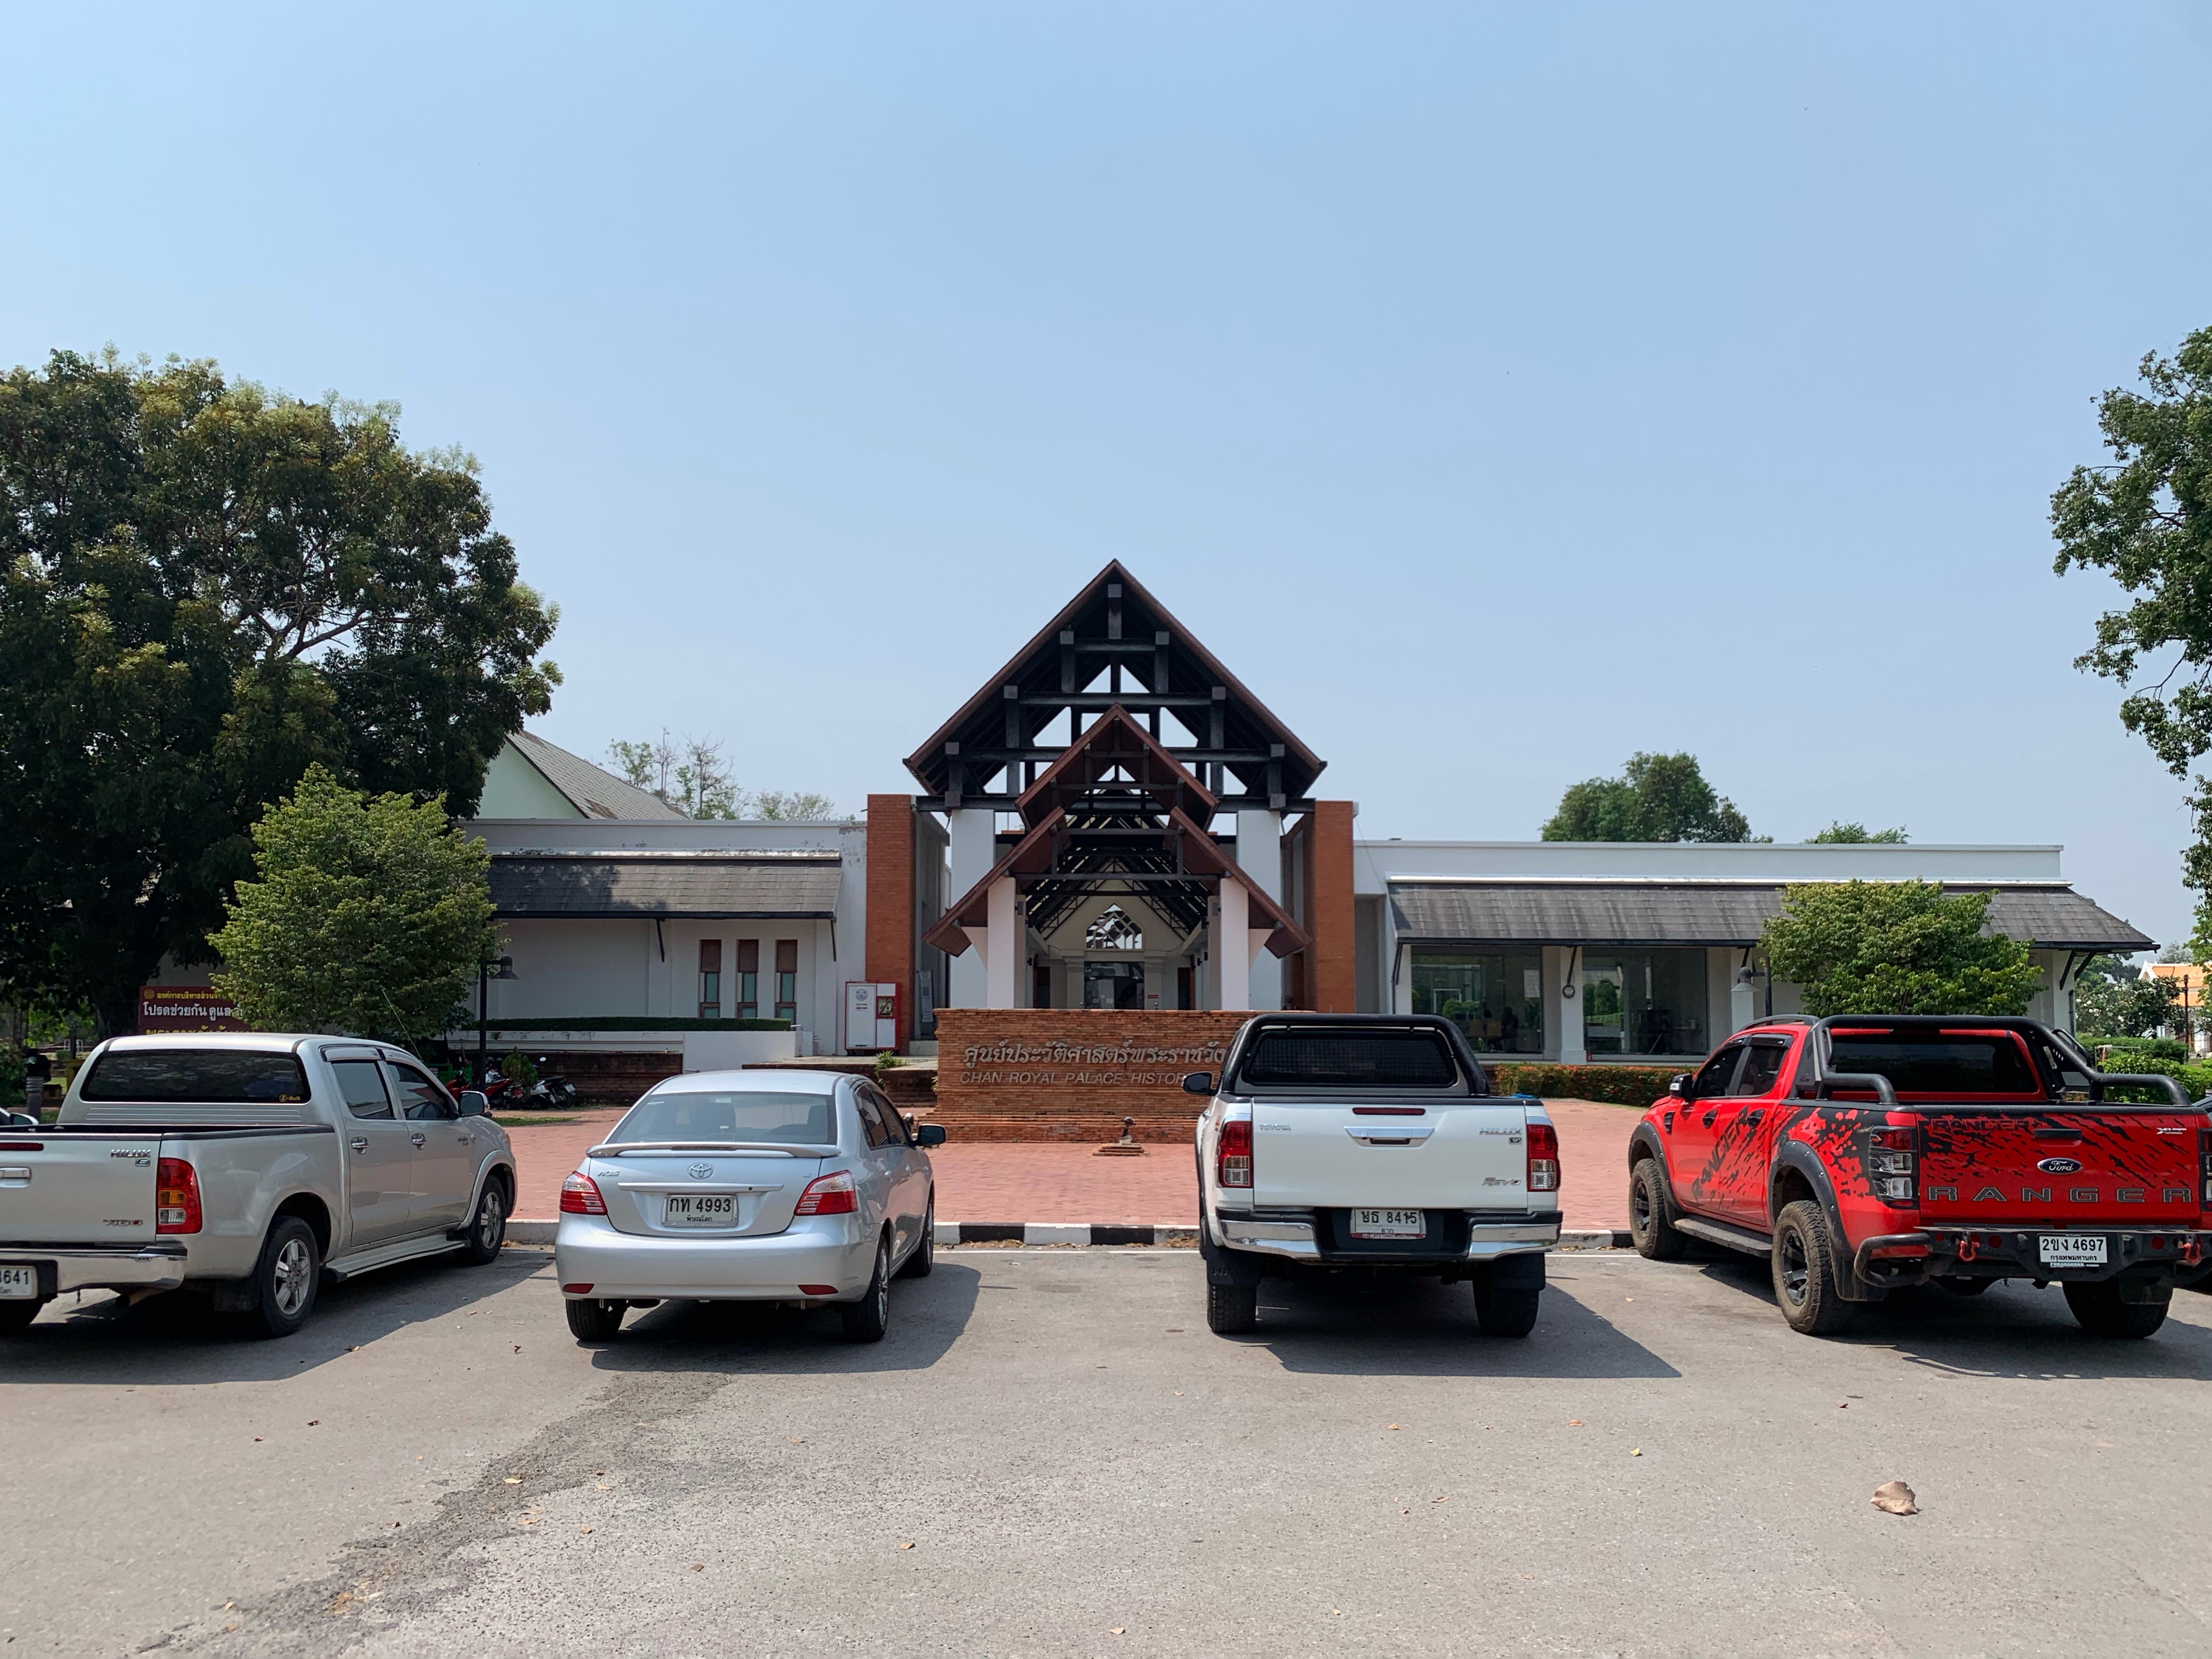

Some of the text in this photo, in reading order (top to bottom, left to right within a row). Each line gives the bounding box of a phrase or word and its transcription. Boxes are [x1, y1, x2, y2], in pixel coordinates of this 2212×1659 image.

[143, 1001, 206, 1016] โปรดช่วยกัน
[209, 1006, 231, 1021] ดูแล
[961, 1071, 1002, 1084] CHAN
[1009, 1071, 1059, 1084] ROYAL
[1065, 1072, 1125, 1085] PALACE
[110, 1149, 151, 1158] HILUX
[2049, 1160, 2074, 1171] Ford
[1928, 1186, 2193, 1203] RANGER
[669, 1198, 731, 1212] กท 4993
[1386, 1211, 1417, 1224] 8415
[2073, 1238, 2104, 1251] 4697
[0, 1269, 29, 1285] 641
